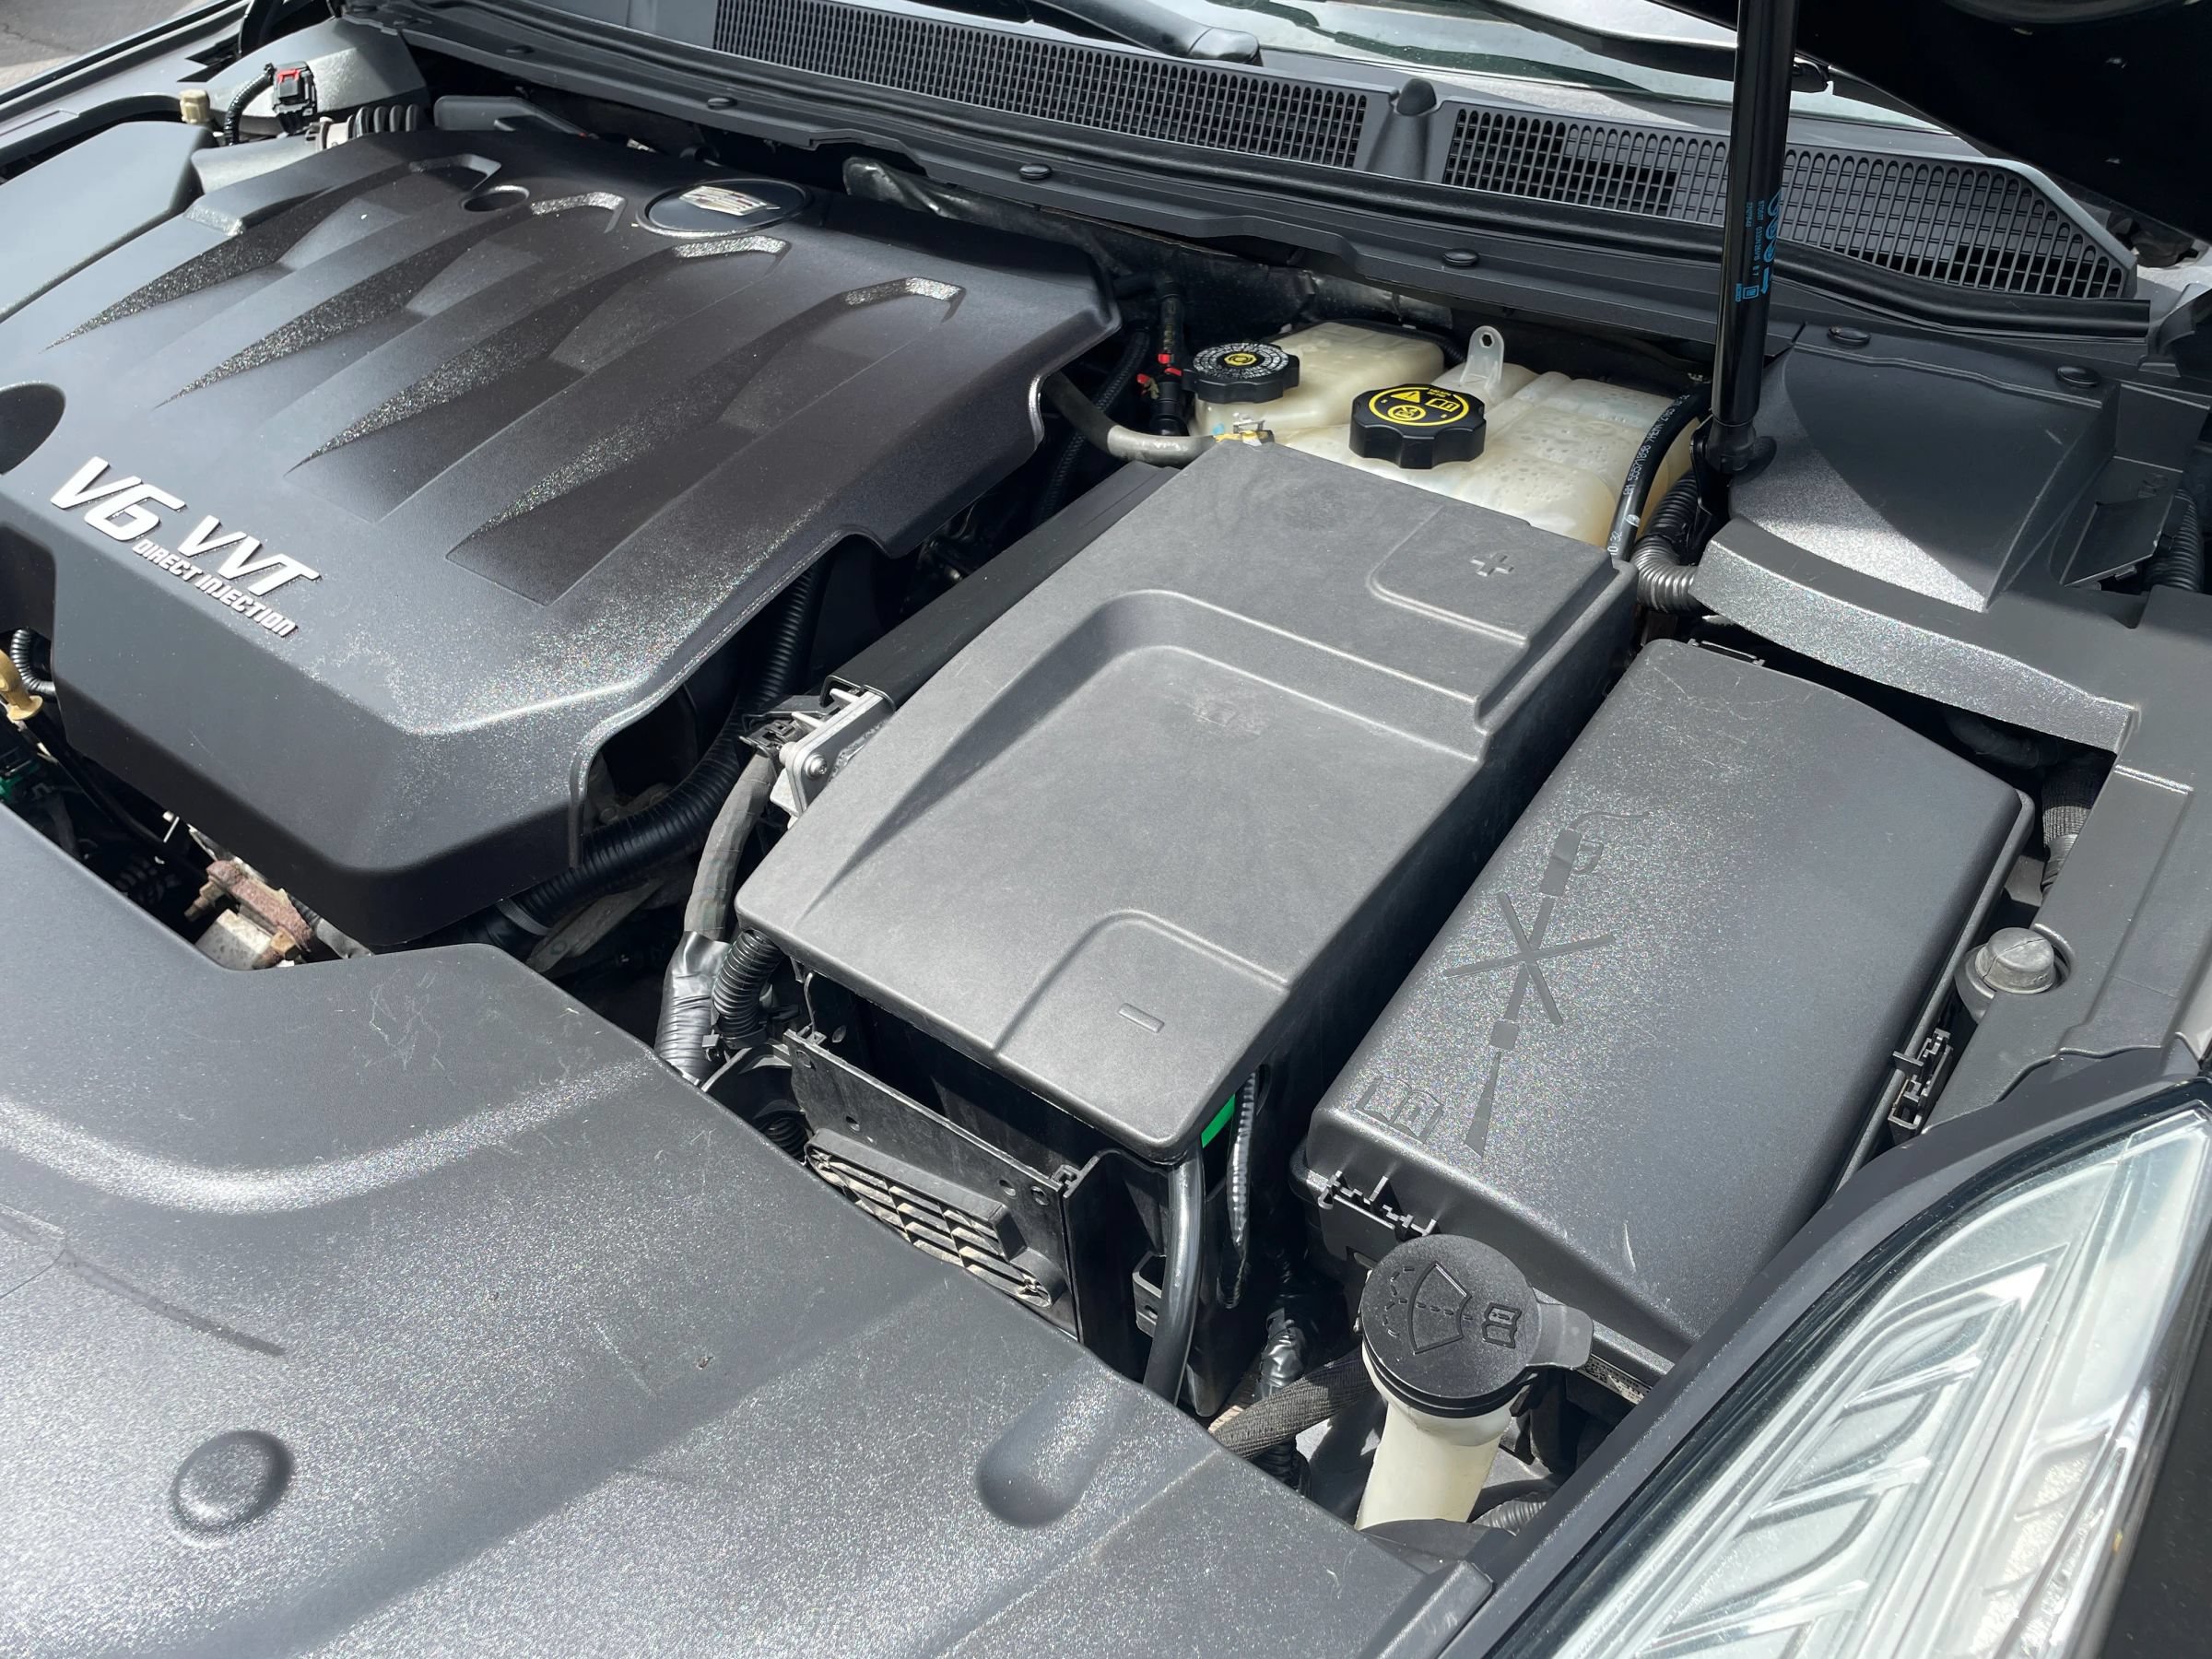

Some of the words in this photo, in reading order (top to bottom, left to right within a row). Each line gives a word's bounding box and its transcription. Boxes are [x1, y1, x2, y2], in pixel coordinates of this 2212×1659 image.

[50, 456, 186, 542] V6
[177, 515, 321, 597] VVT
[132, 538, 203, 582] DIRECT
